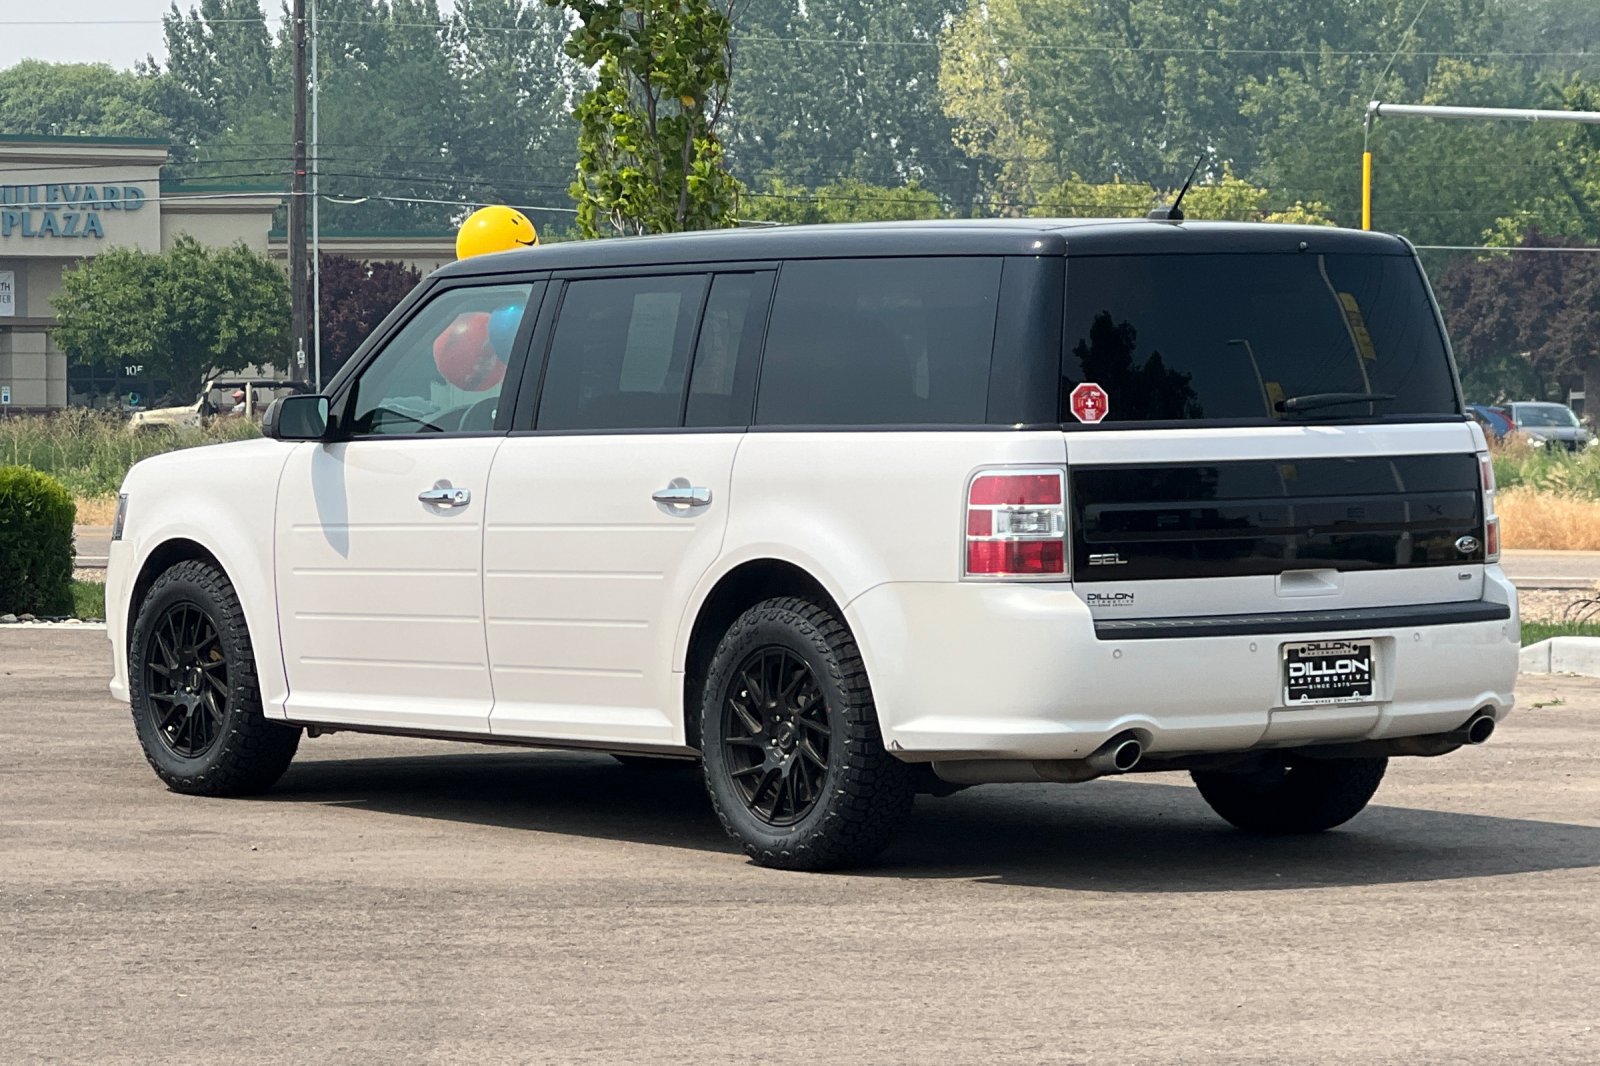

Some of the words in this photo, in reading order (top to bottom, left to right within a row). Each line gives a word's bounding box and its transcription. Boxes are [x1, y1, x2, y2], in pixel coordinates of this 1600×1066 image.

[0, 184, 145, 211] ULEVARD
[2, 210, 104, 238] PLAZA
[1089, 553, 1128, 565] SEL
[1087, 592, 1134, 600] DILLON
[1308, 642, 1351, 651] DILLON
[1289, 658, 1369, 677] DILLON
[1290, 674, 1369, 685] AUTOMOTIVE
